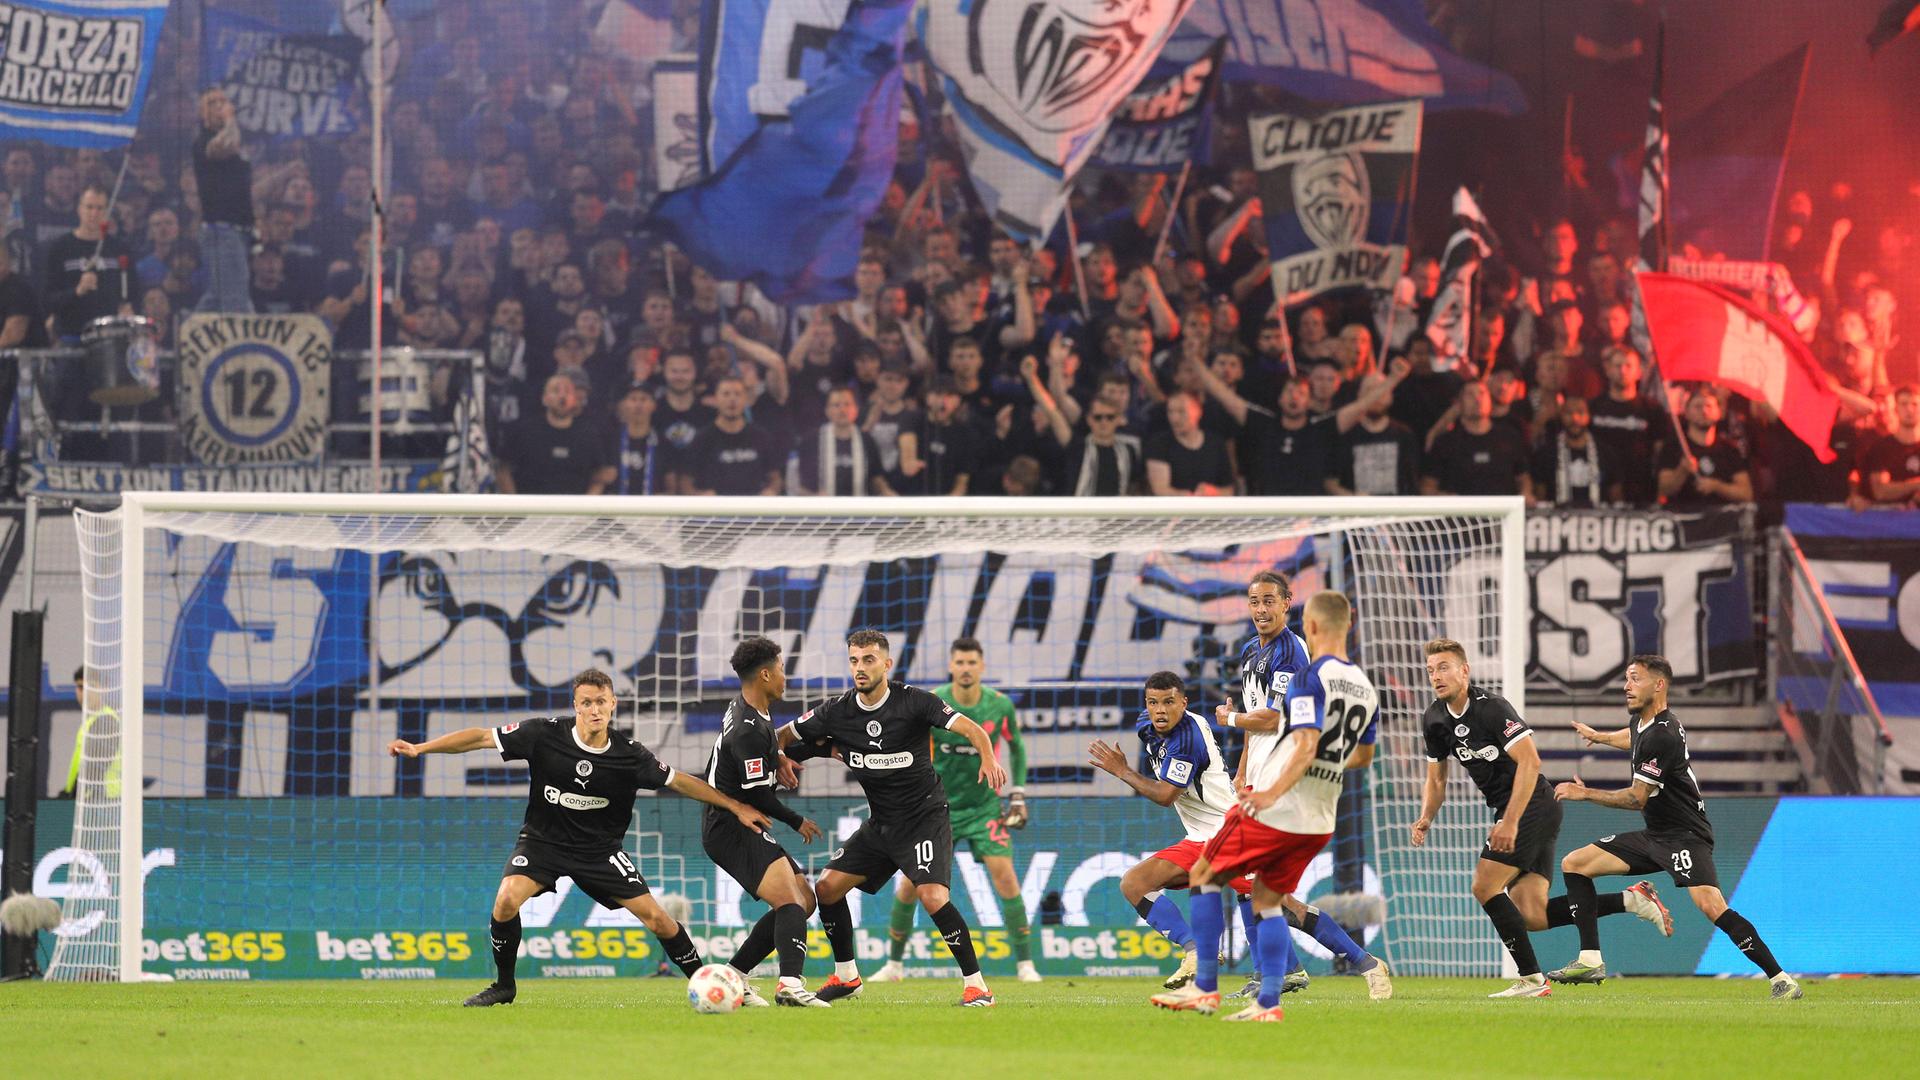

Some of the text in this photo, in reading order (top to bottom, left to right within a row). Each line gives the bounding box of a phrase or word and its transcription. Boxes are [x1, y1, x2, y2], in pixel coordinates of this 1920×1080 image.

[0, 62, 133, 108] ARCELLO
[1102, 118, 1197, 166] QUE
[1263, 110, 1403, 158] CLIQUE
[224, 368, 276, 417] 12
[45, 465, 412, 494] SEKTION STADIONVERBOT
[1525, 515, 1675, 554] AMBURG
[1316, 698, 1367, 764] 28
[868, 755, 909, 767] congstar
[1171, 769, 1186, 779] PLAN
[564, 797, 605, 807] congstar
[608, 851, 637, 877] 19
[914, 840, 934, 865] 10
[1672, 849, 1693, 872] 28
[315, 931, 472, 961] bet365
[1041, 929, 1187, 960] bet36
[175, 968, 249, 980] SPORTWETTEN
[361, 968, 435, 980] SPORTWETTEN
[541, 965, 615, 978] SPORTWETTEN
